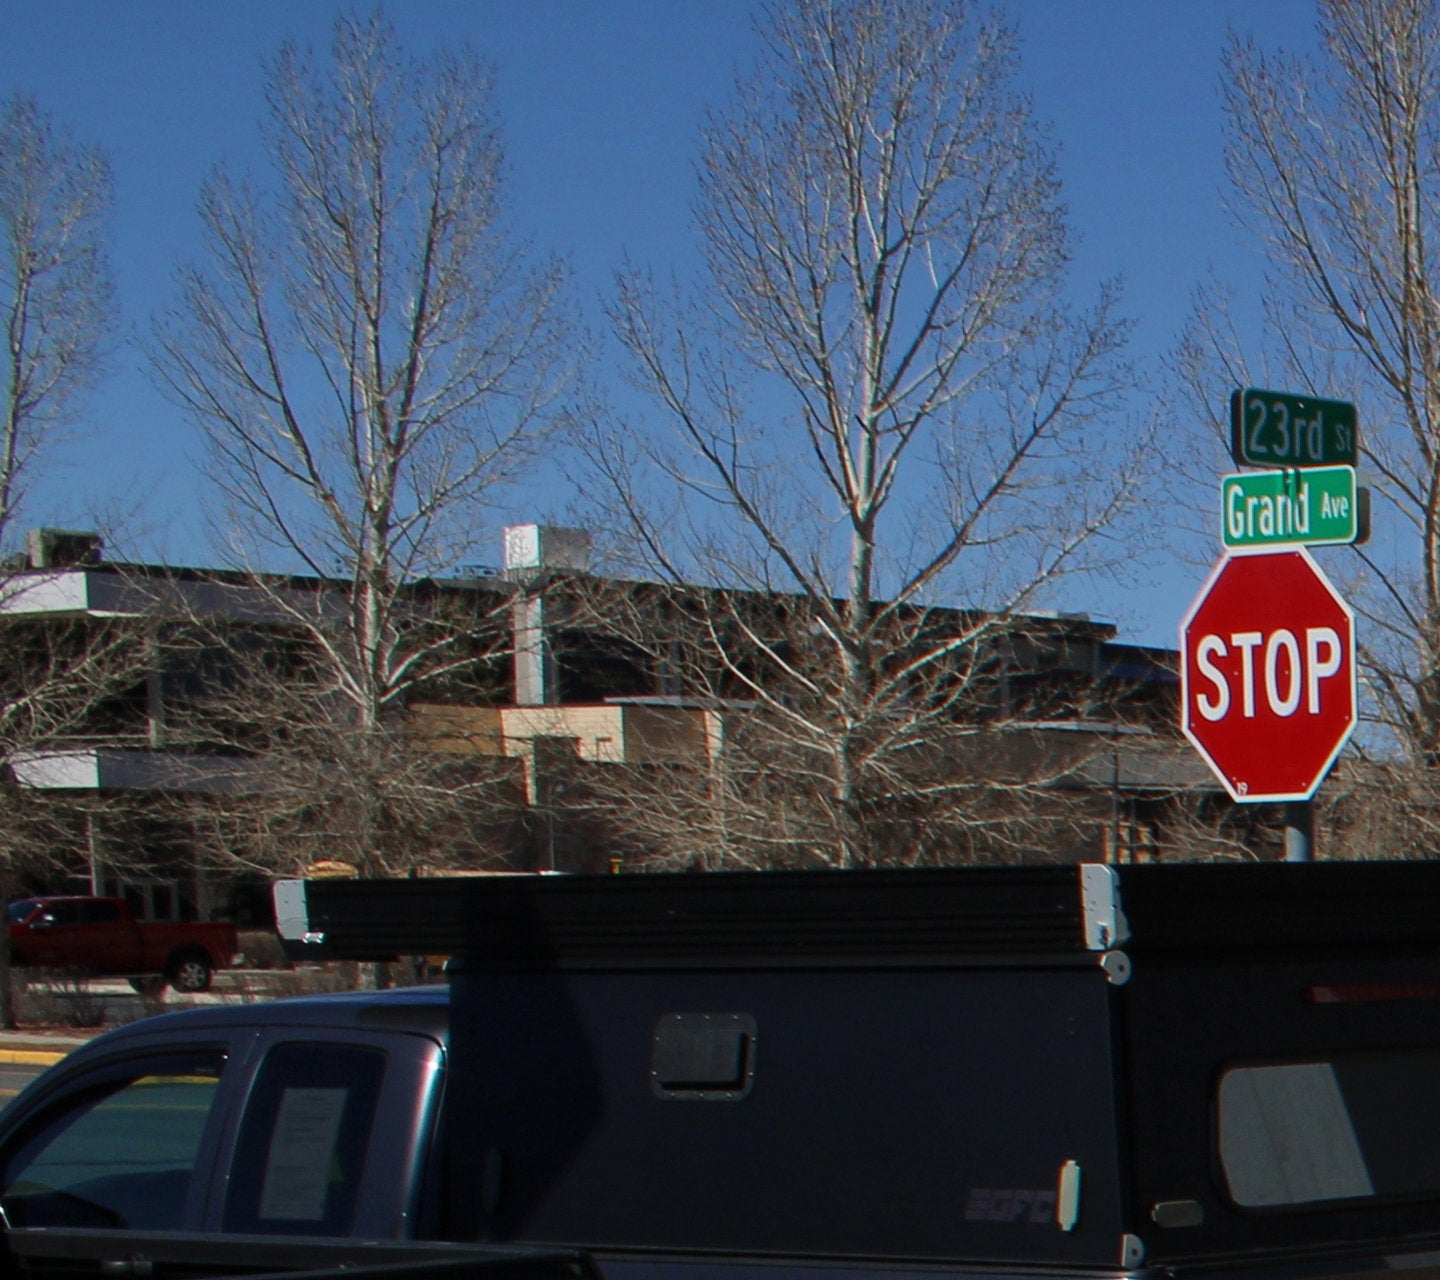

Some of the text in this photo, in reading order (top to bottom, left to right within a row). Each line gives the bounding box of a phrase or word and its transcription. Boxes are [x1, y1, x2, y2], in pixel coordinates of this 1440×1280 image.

[1248, 398, 1353, 462] 23rd St
[1227, 482, 1349, 539] Grand Ave
[1196, 626, 1342, 722] STOP
